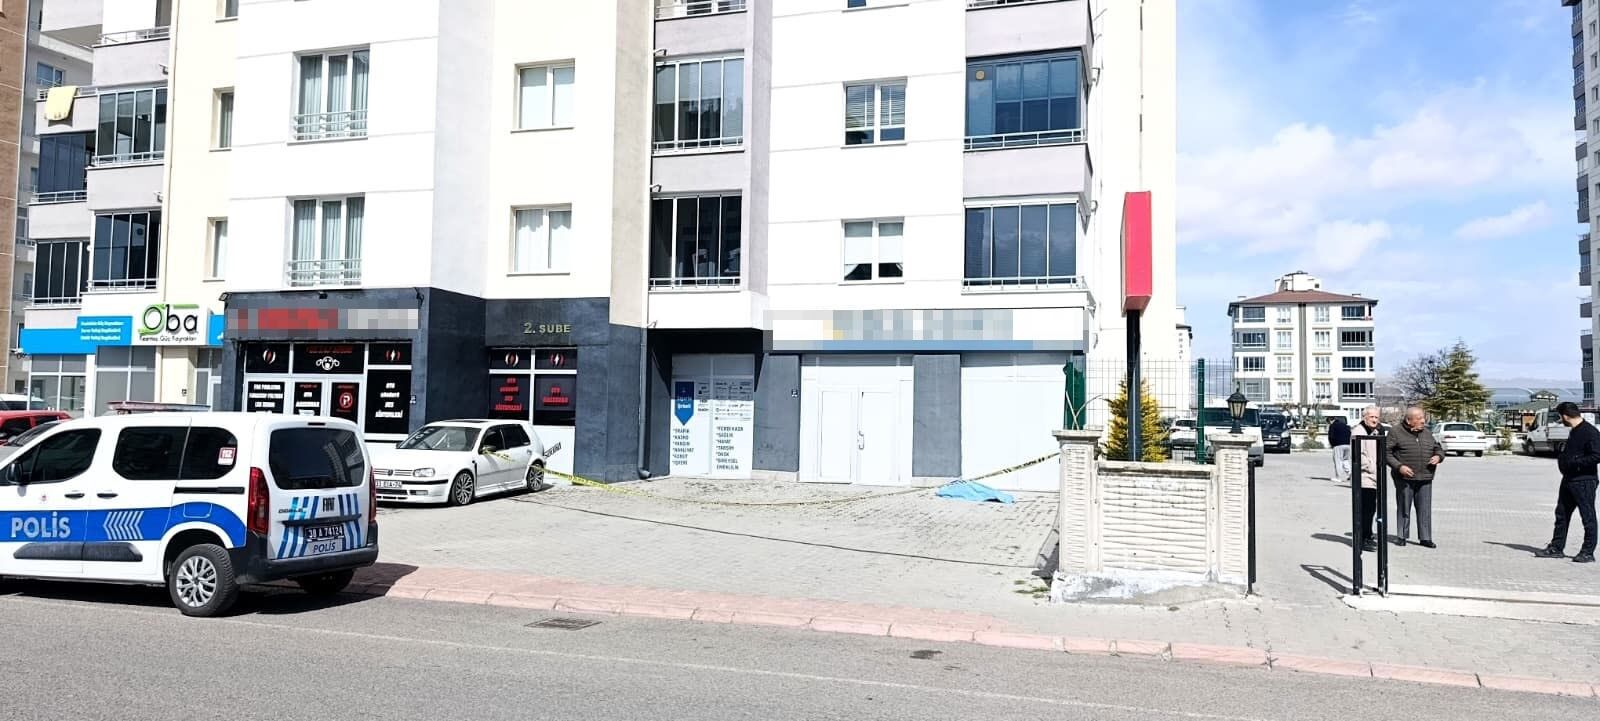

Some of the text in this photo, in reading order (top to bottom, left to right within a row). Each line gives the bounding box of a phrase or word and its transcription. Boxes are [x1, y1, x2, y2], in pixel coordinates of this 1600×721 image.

[142, 303, 198, 334] Oba
[322, 497, 335, 512] FIAT
[11, 511, 71, 539] POLİS
[313, 541, 336, 553] POLİS
